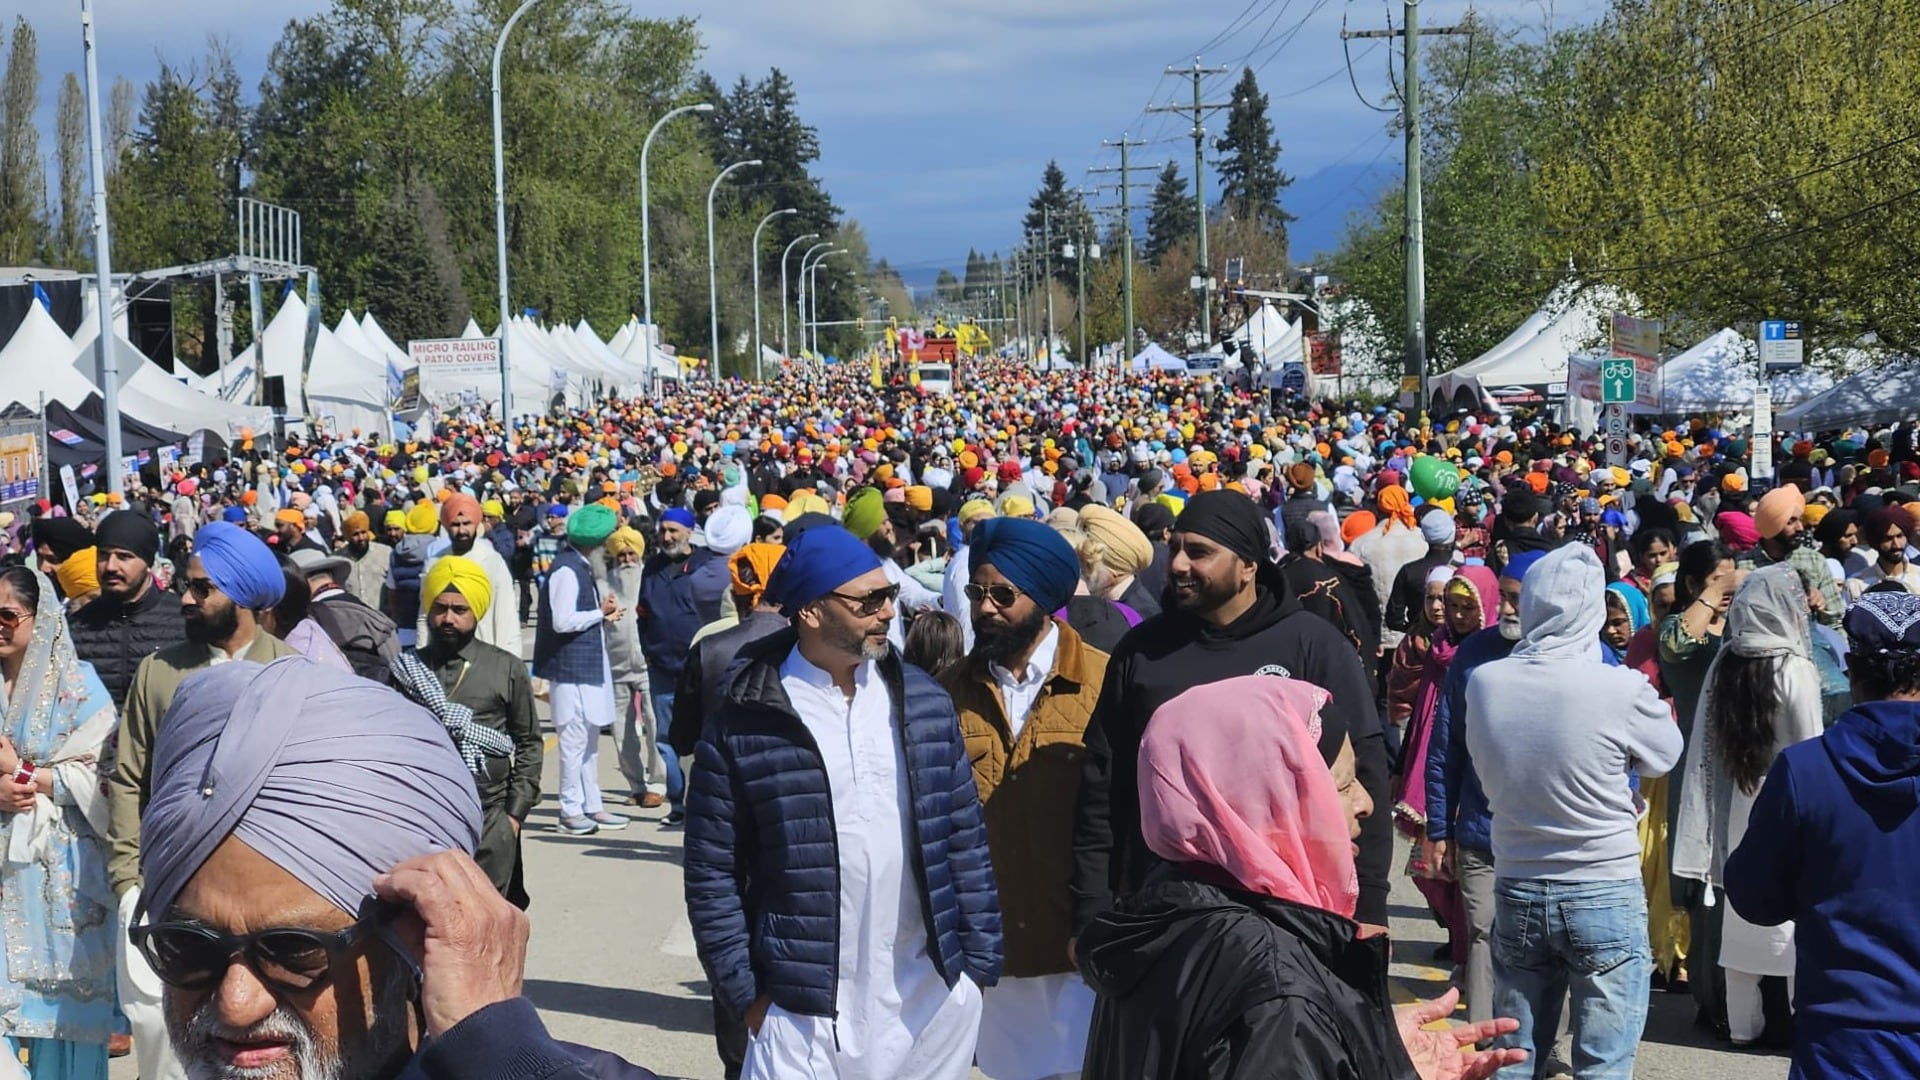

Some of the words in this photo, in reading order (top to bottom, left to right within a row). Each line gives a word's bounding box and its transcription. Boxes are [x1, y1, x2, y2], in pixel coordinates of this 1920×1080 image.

[1768, 324, 1780, 338] T
[413, 343, 449, 353] MICRO
[452, 341, 496, 352] RAILING
[424, 354, 453, 363] PATIO
[456, 353, 496, 362] COVERS
